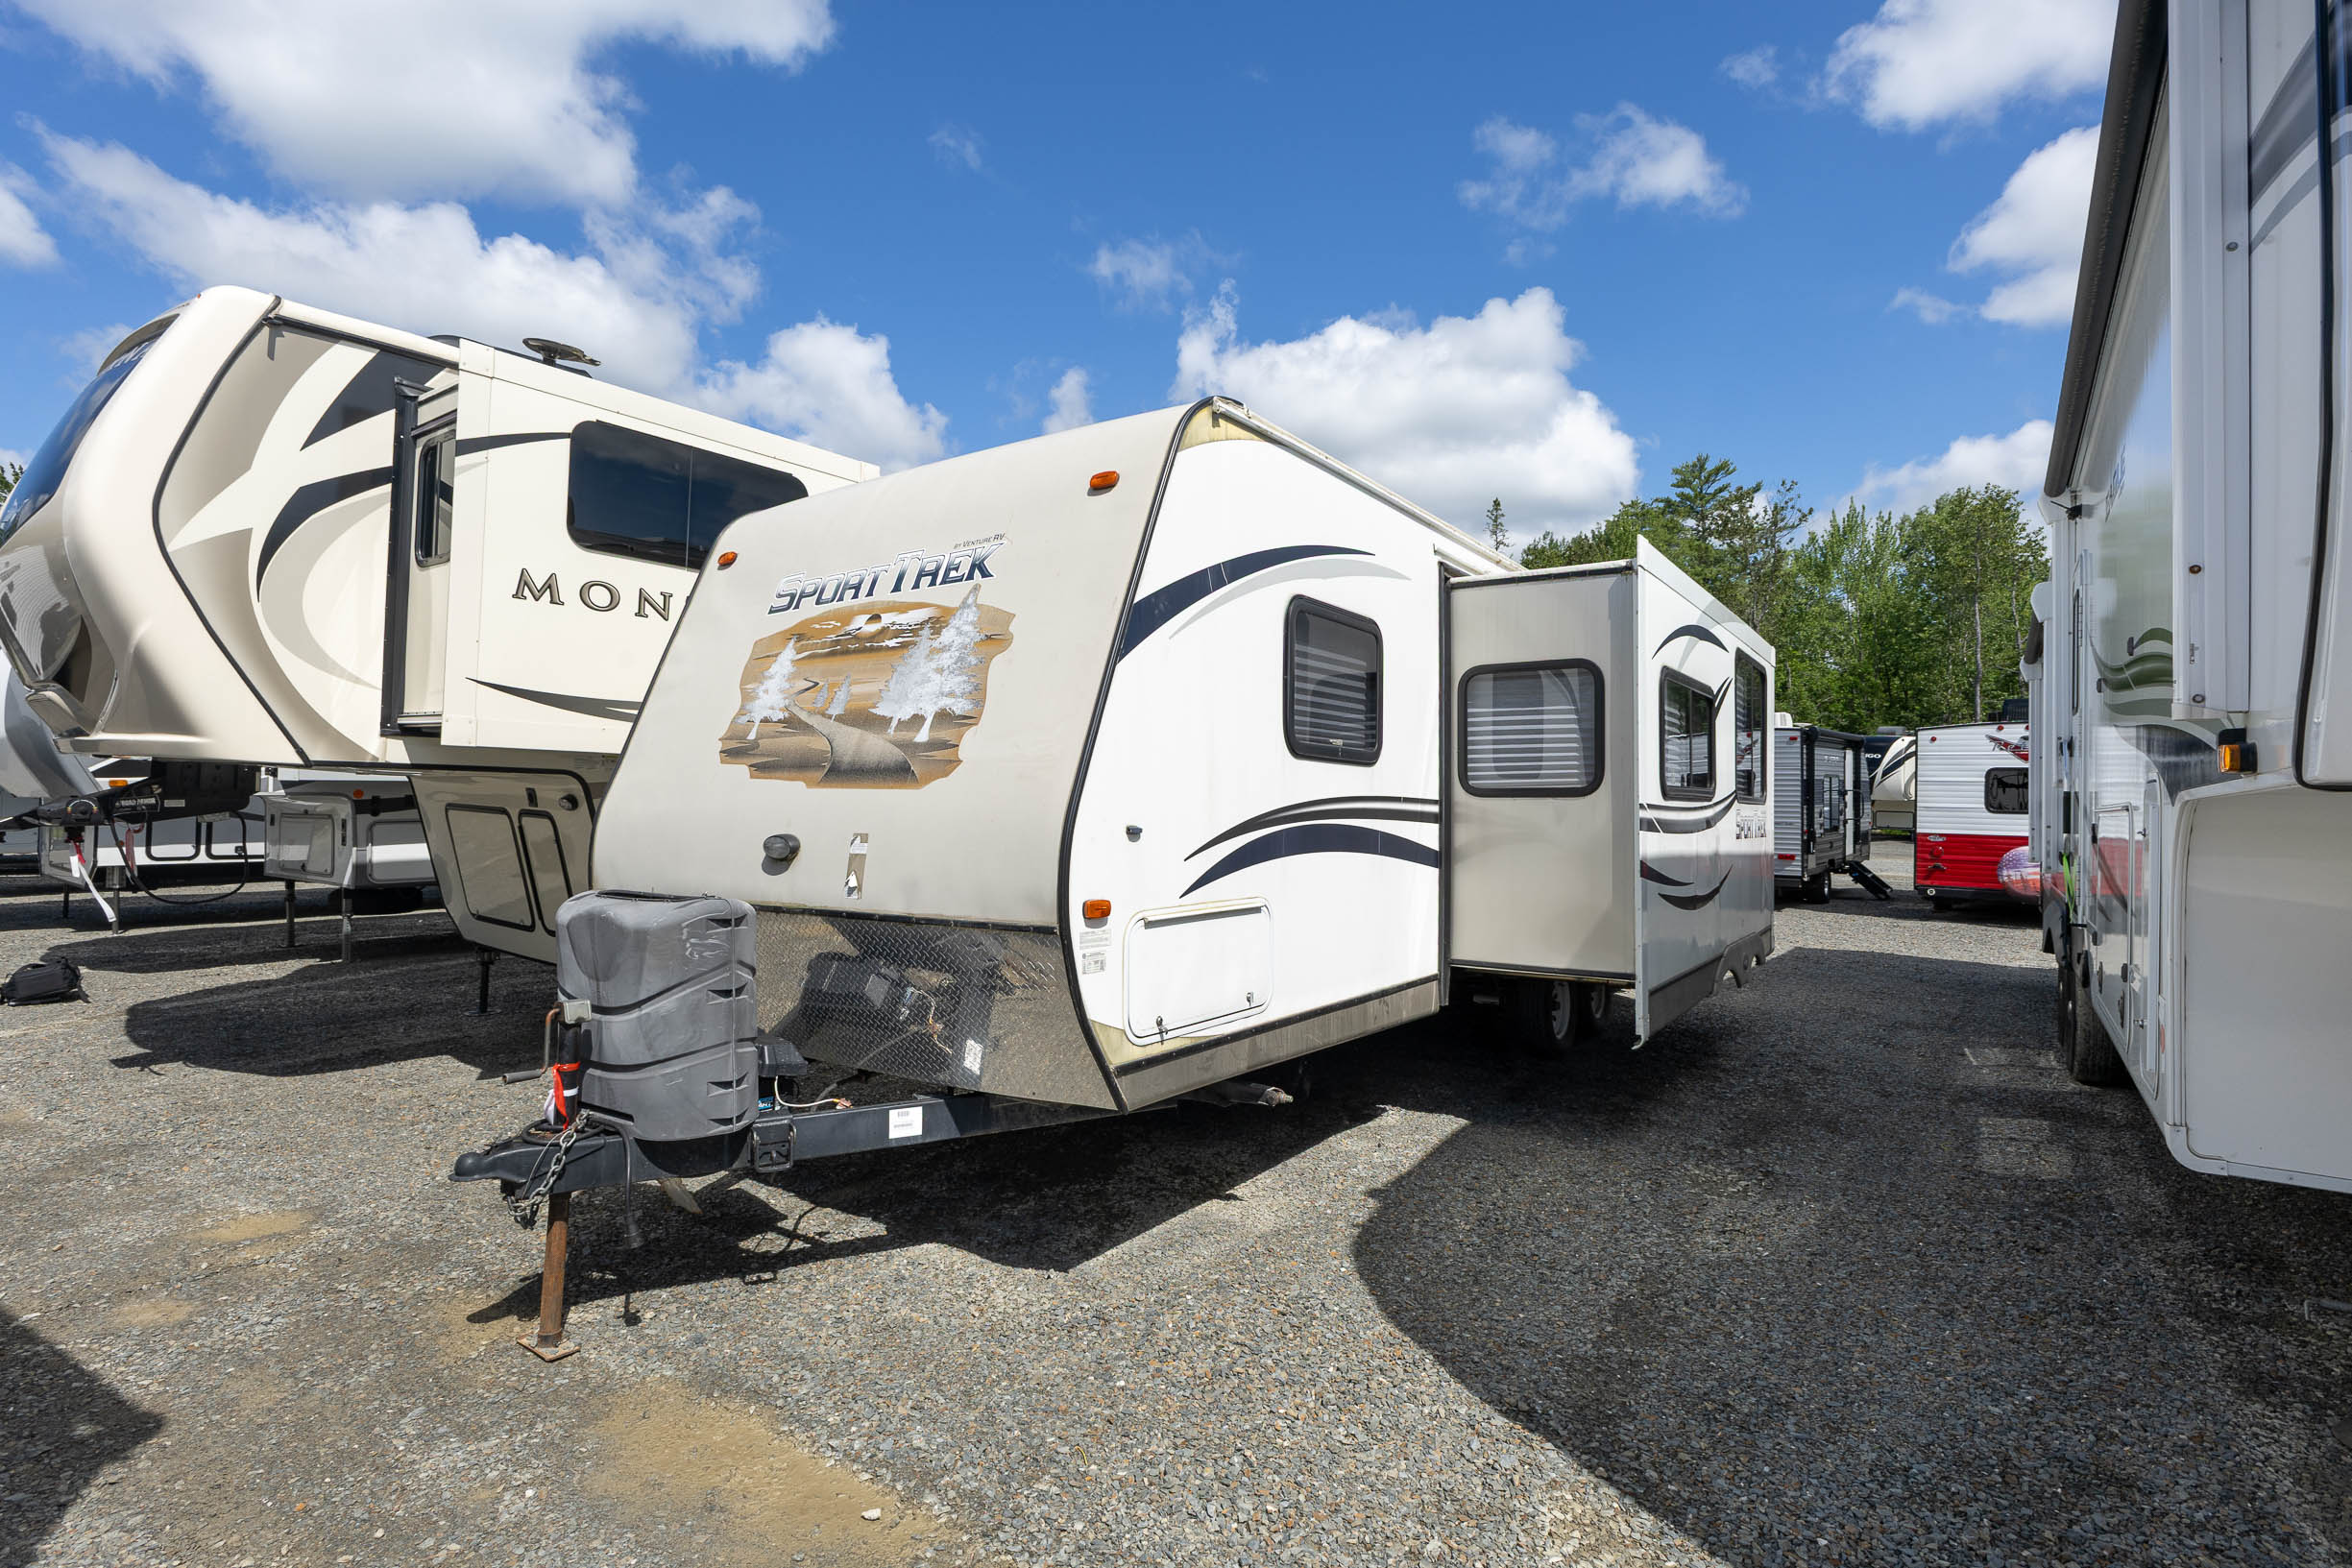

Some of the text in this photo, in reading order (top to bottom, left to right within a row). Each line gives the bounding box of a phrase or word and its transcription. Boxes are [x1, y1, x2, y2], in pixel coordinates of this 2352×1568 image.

[963, 537, 993, 547] VENTURE
[993, 533, 1006, 542] RV
[512, 567, 690, 621] MON
